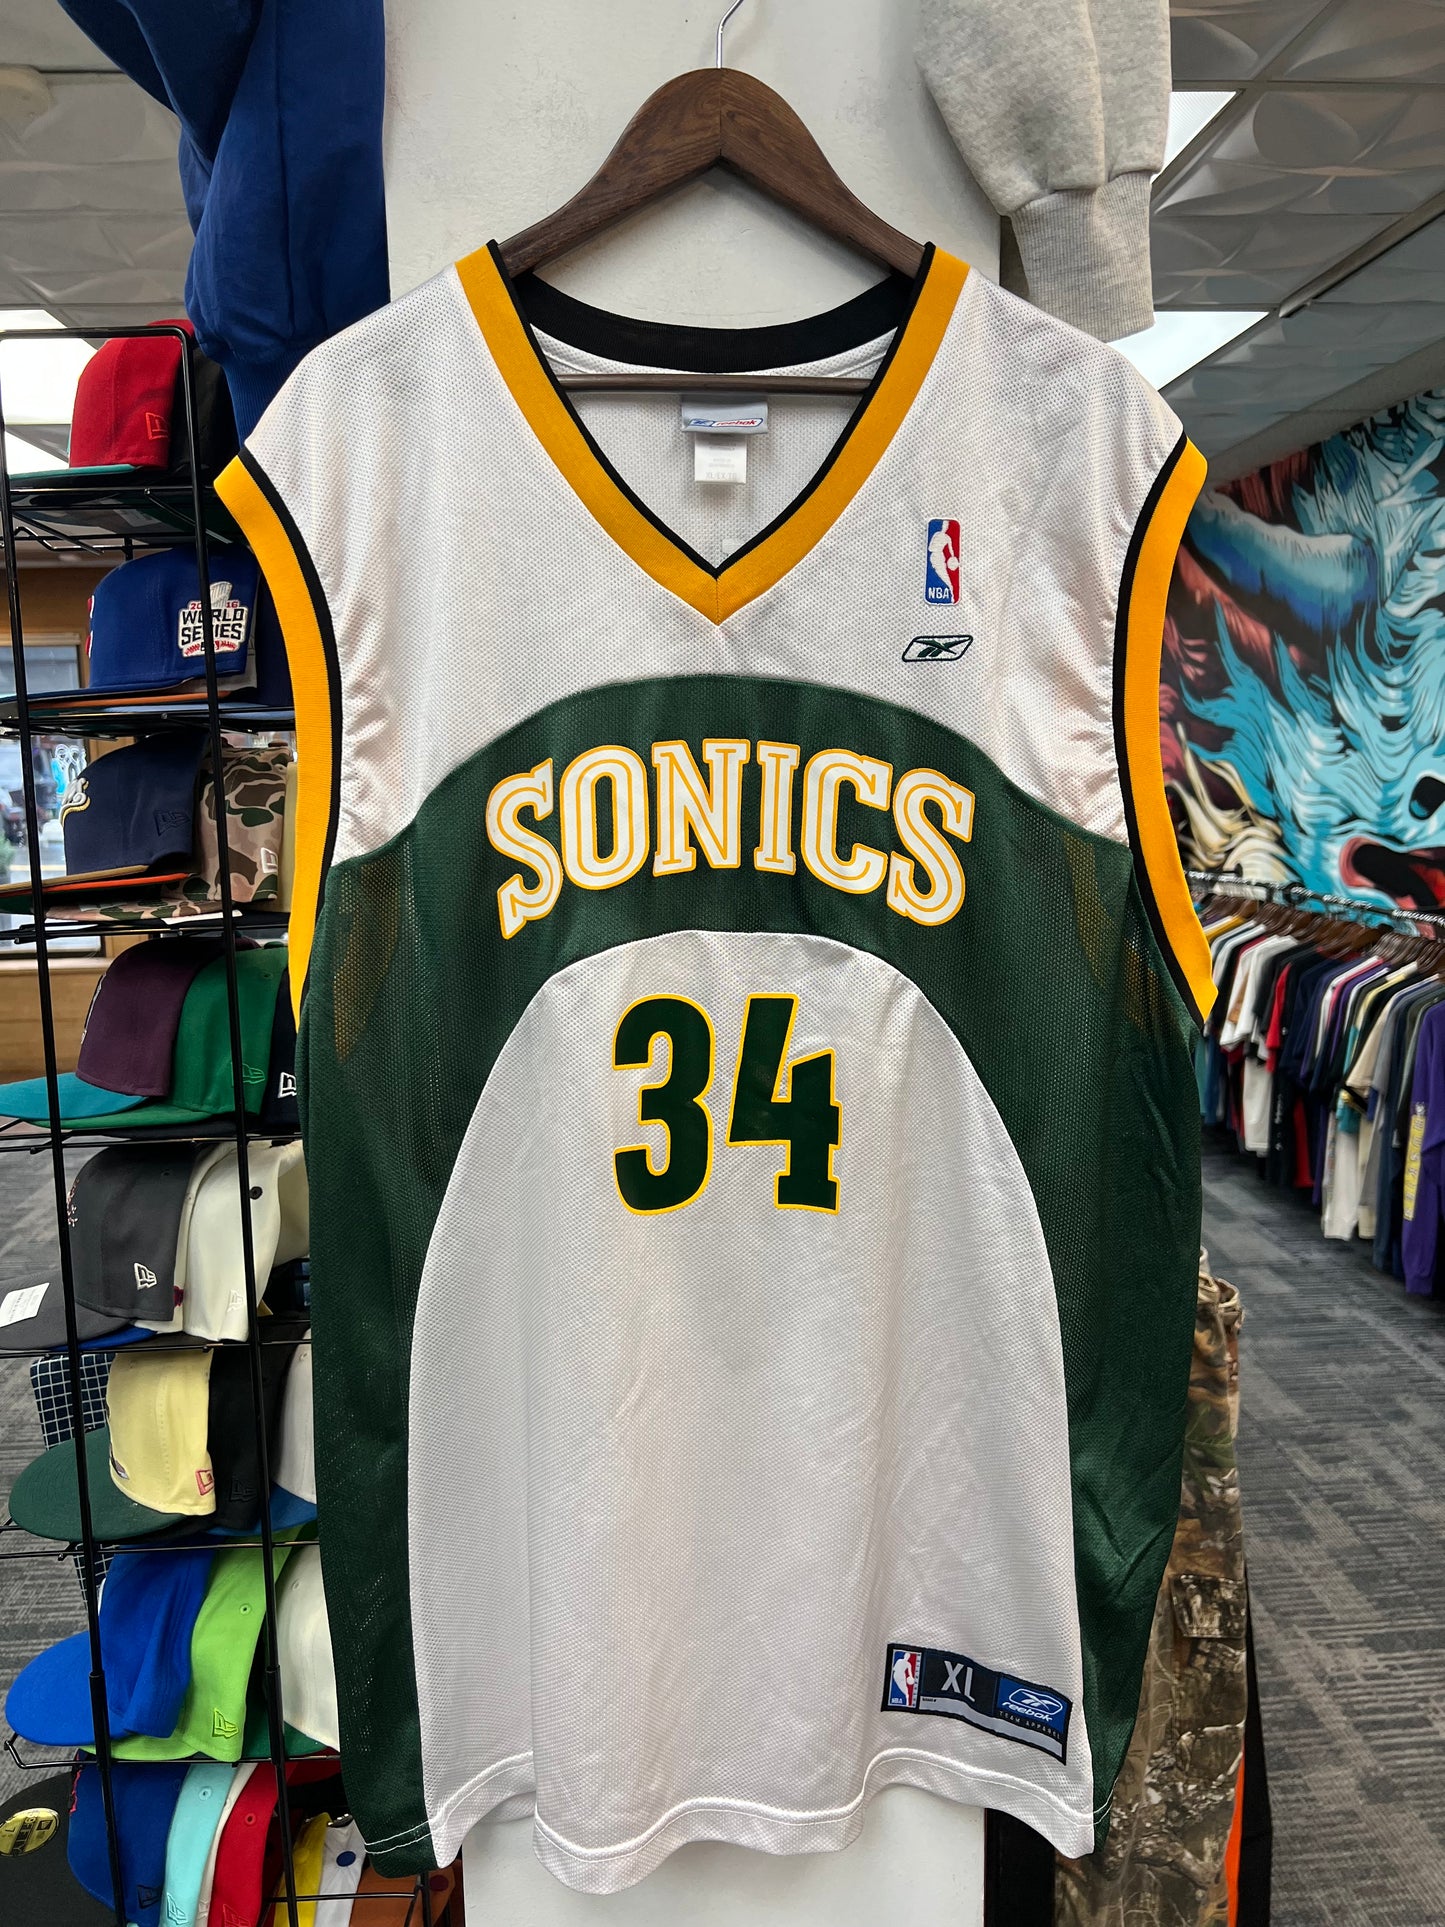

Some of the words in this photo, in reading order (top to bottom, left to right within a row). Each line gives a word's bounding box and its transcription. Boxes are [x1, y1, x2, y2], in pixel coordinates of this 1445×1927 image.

[928, 587, 950, 599] NBA
[181, 623, 243, 646] SEIES
[486, 738, 975, 940] SONICS
[612, 993, 842, 1216] 34
[941, 1660, 976, 1703] XL
[1002, 1701, 1053, 1722] reebok
